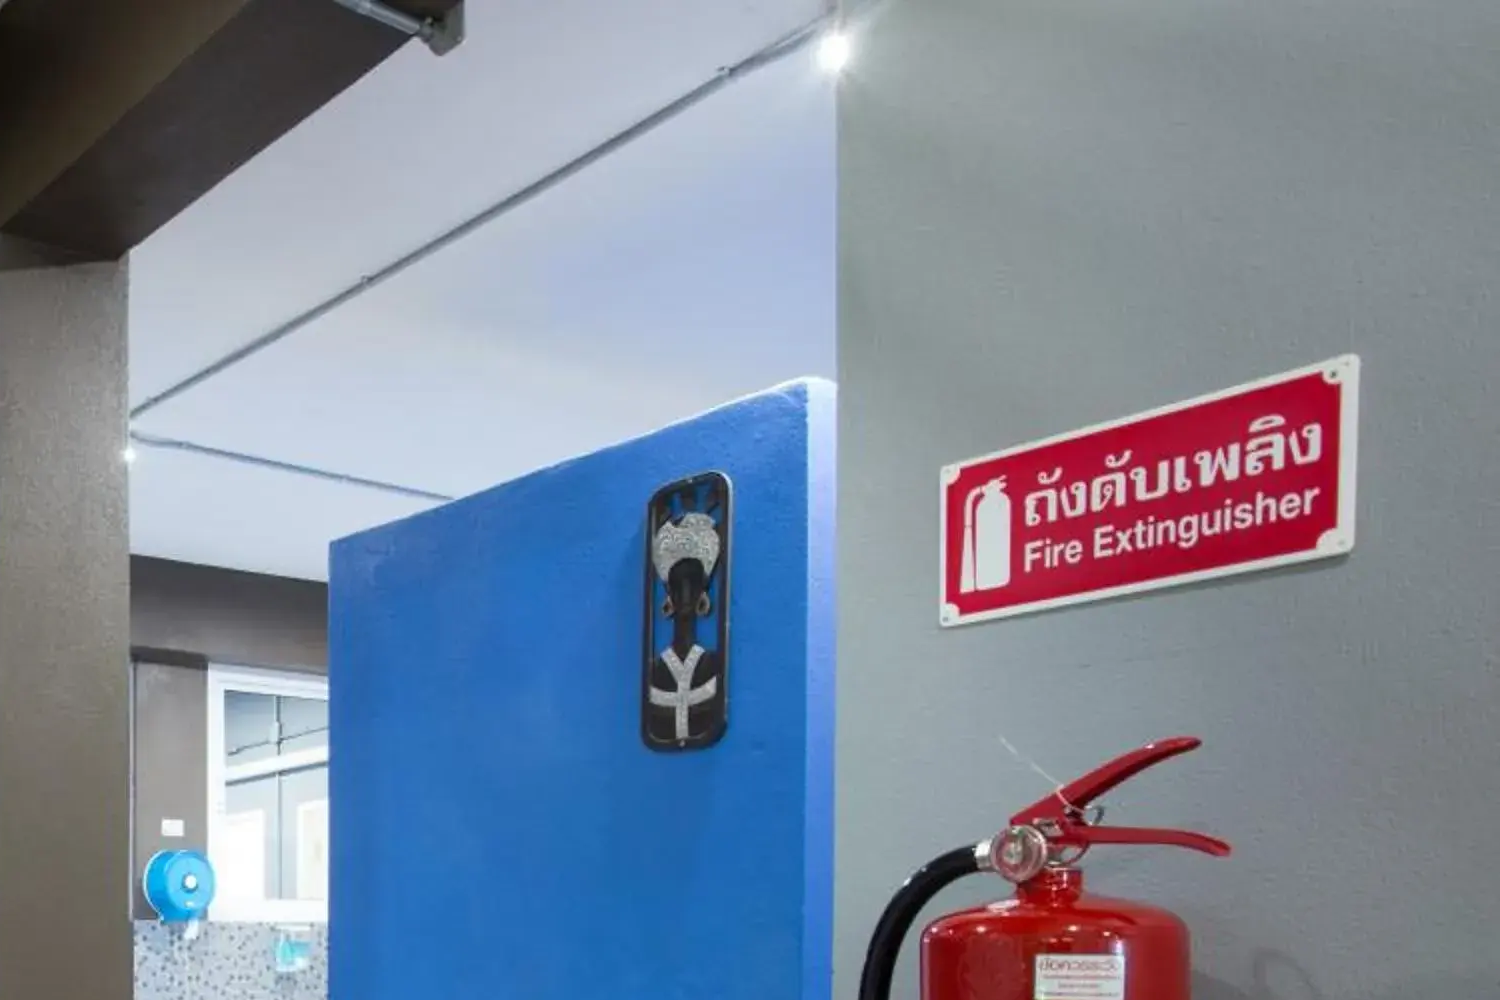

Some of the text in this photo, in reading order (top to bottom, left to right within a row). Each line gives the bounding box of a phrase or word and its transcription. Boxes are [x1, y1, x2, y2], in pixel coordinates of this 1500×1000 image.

[1023, 414, 1323, 527] ถังดับเพลิง
[1023, 485, 1320, 573] Fire Extinguisher
